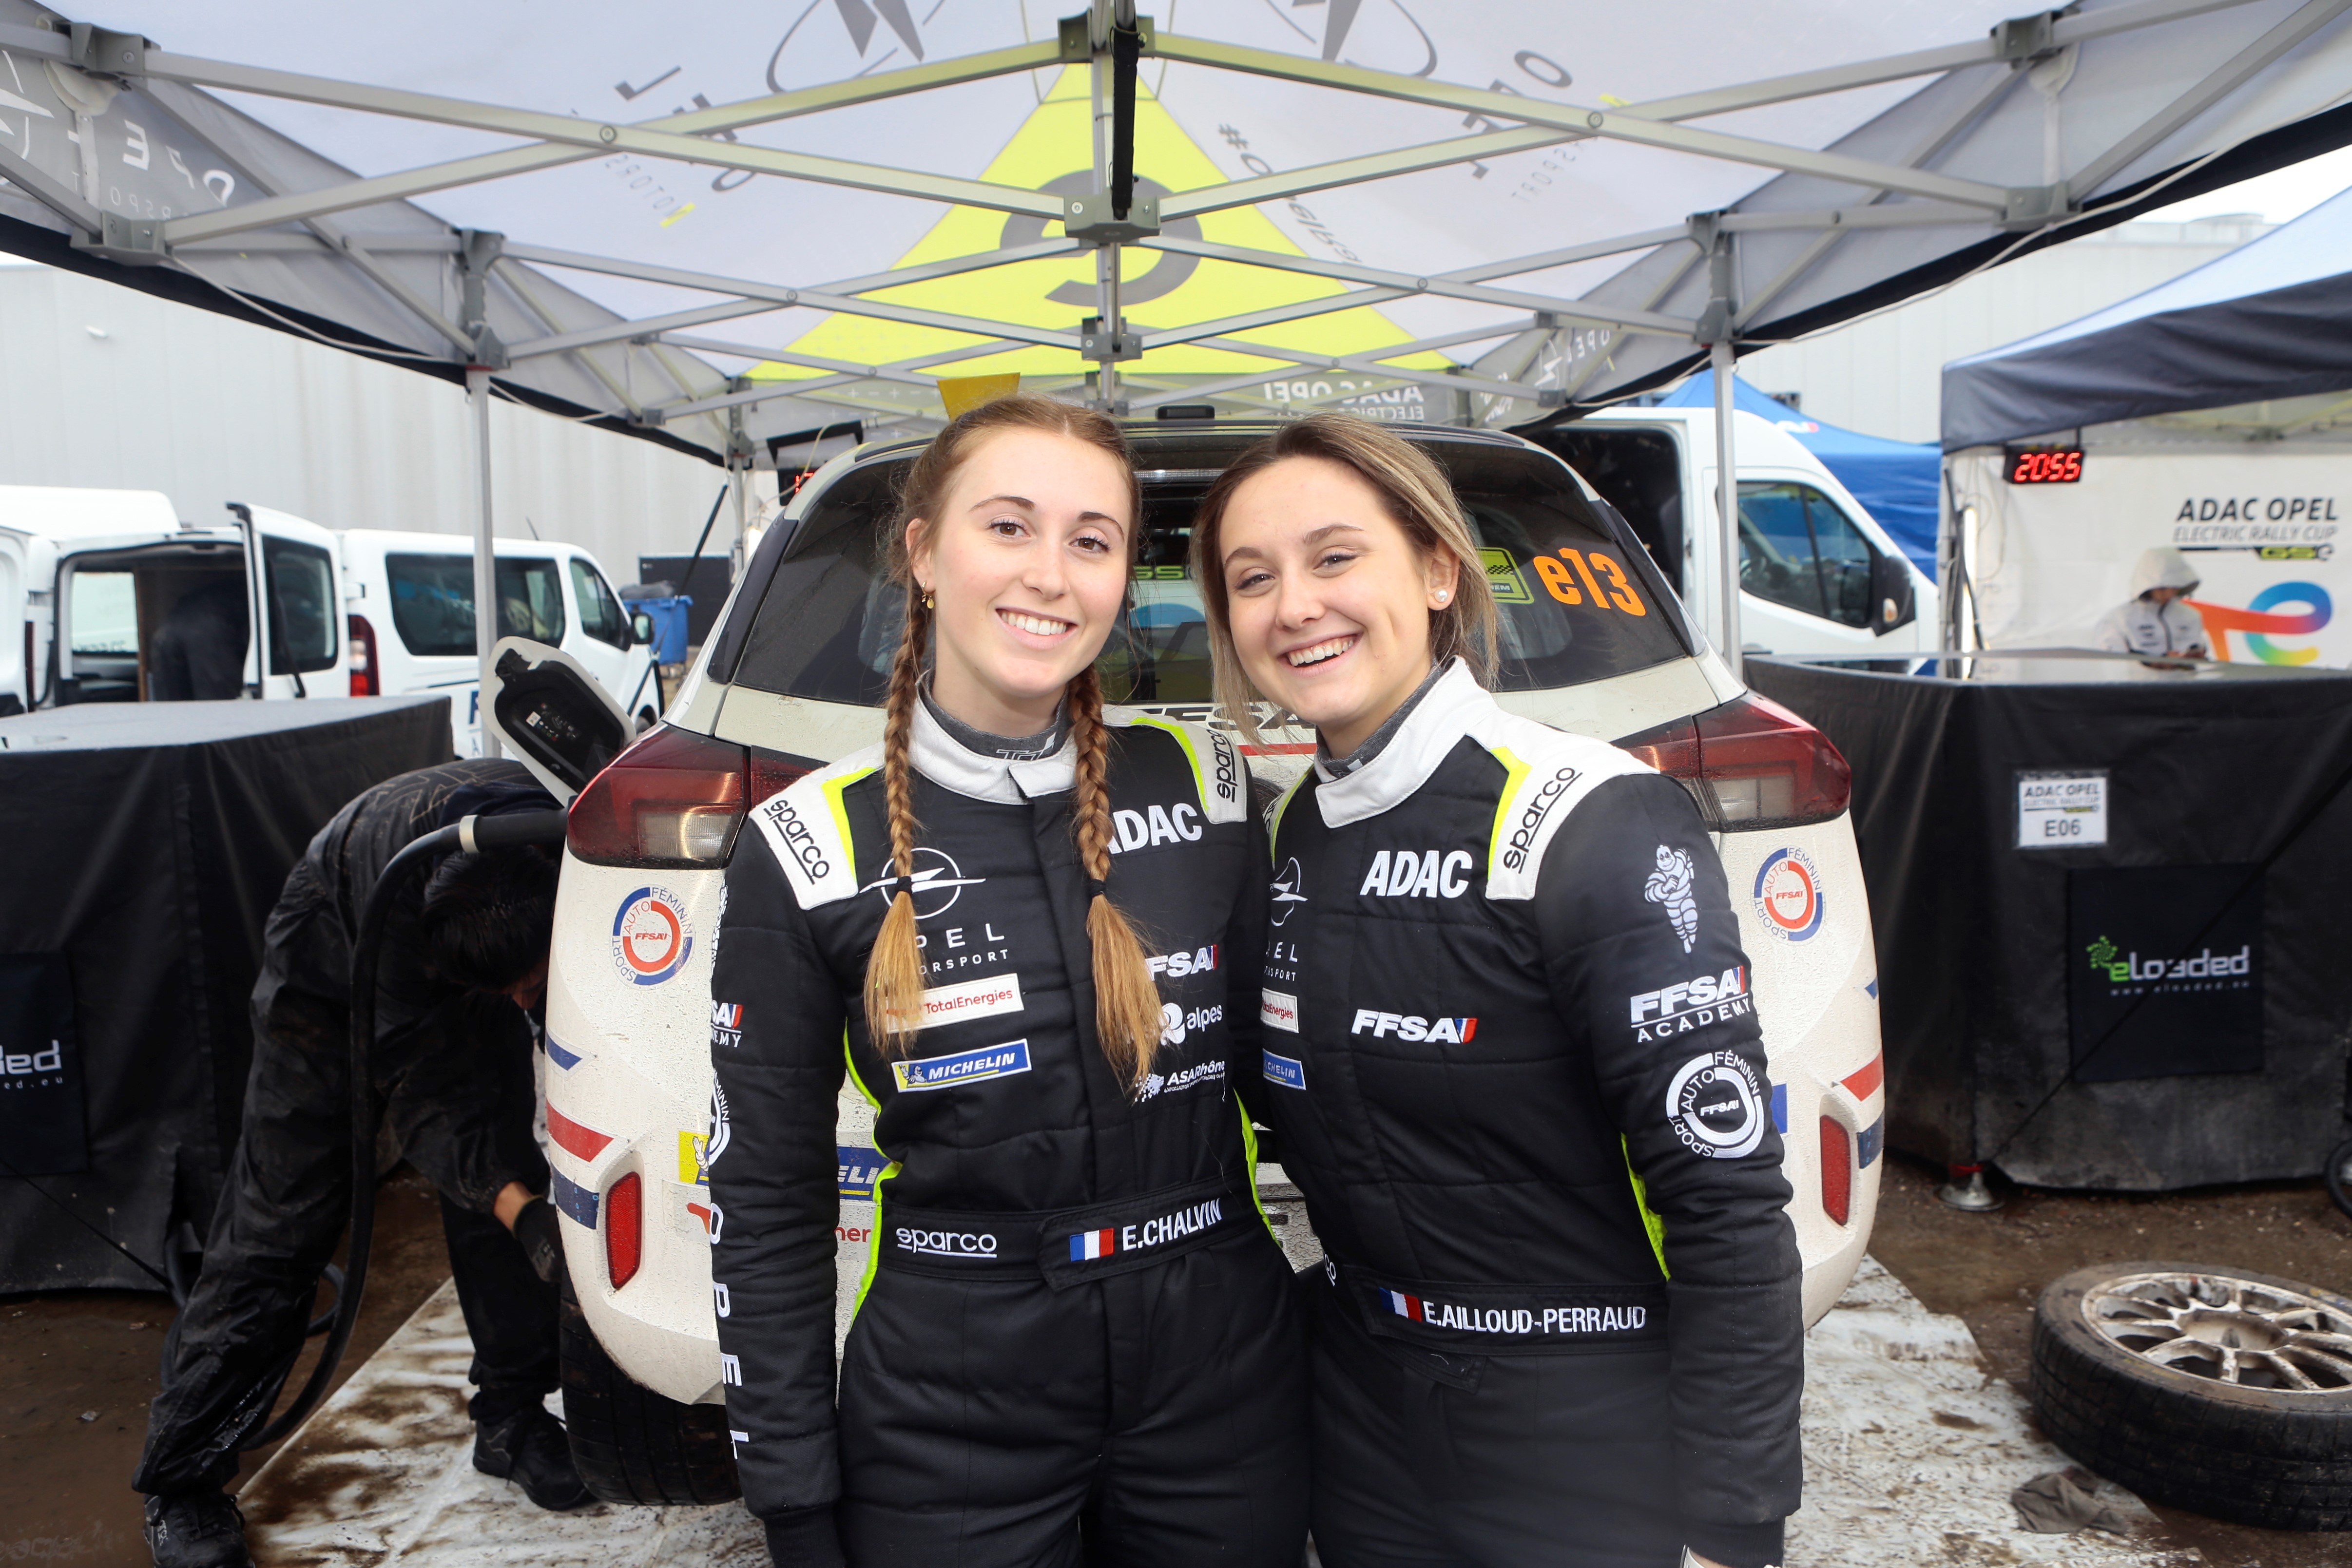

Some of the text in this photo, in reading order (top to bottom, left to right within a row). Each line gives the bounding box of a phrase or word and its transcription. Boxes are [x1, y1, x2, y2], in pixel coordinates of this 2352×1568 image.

[2177, 497, 2338, 521] ADAC OPEL
[2173, 525, 2337, 542] ELECTRIC RALLY CUP
[1533, 547, 1646, 616] e13
[1503, 767, 1579, 873] sparco
[2045, 819, 2081, 837] E06
[764, 800, 830, 883] sparco
[1359, 850, 1473, 899] ADAC
[1764, 861, 1788, 895] AUTO
[623, 901, 650, 935] AUTO
[1754, 899, 1787, 939] SPORT
[612, 937, 636, 982] SPORT
[1145, 945, 1215, 981] FSA
[924, 990, 1013, 1014] TotalEnergies
[1630, 967, 1743, 1024] FFSA
[1186, 1005, 1222, 1032] alpes
[1351, 1009, 1467, 1044] FFSA
[1637, 997, 1751, 1043] ACADEMY
[928, 1051, 1016, 1081] MICHELIN
[1715, 1050, 1760, 1095] FÉMININ
[1680, 1070, 1715, 1112] AUTO
[1668, 1118, 1715, 1157] SPORT
[896, 1227, 998, 1257] sparco
[1123, 1198, 1223, 1252] E.CHALVIN
[1424, 1300, 1647, 1334] E.AILLOUD-PERRAUD
